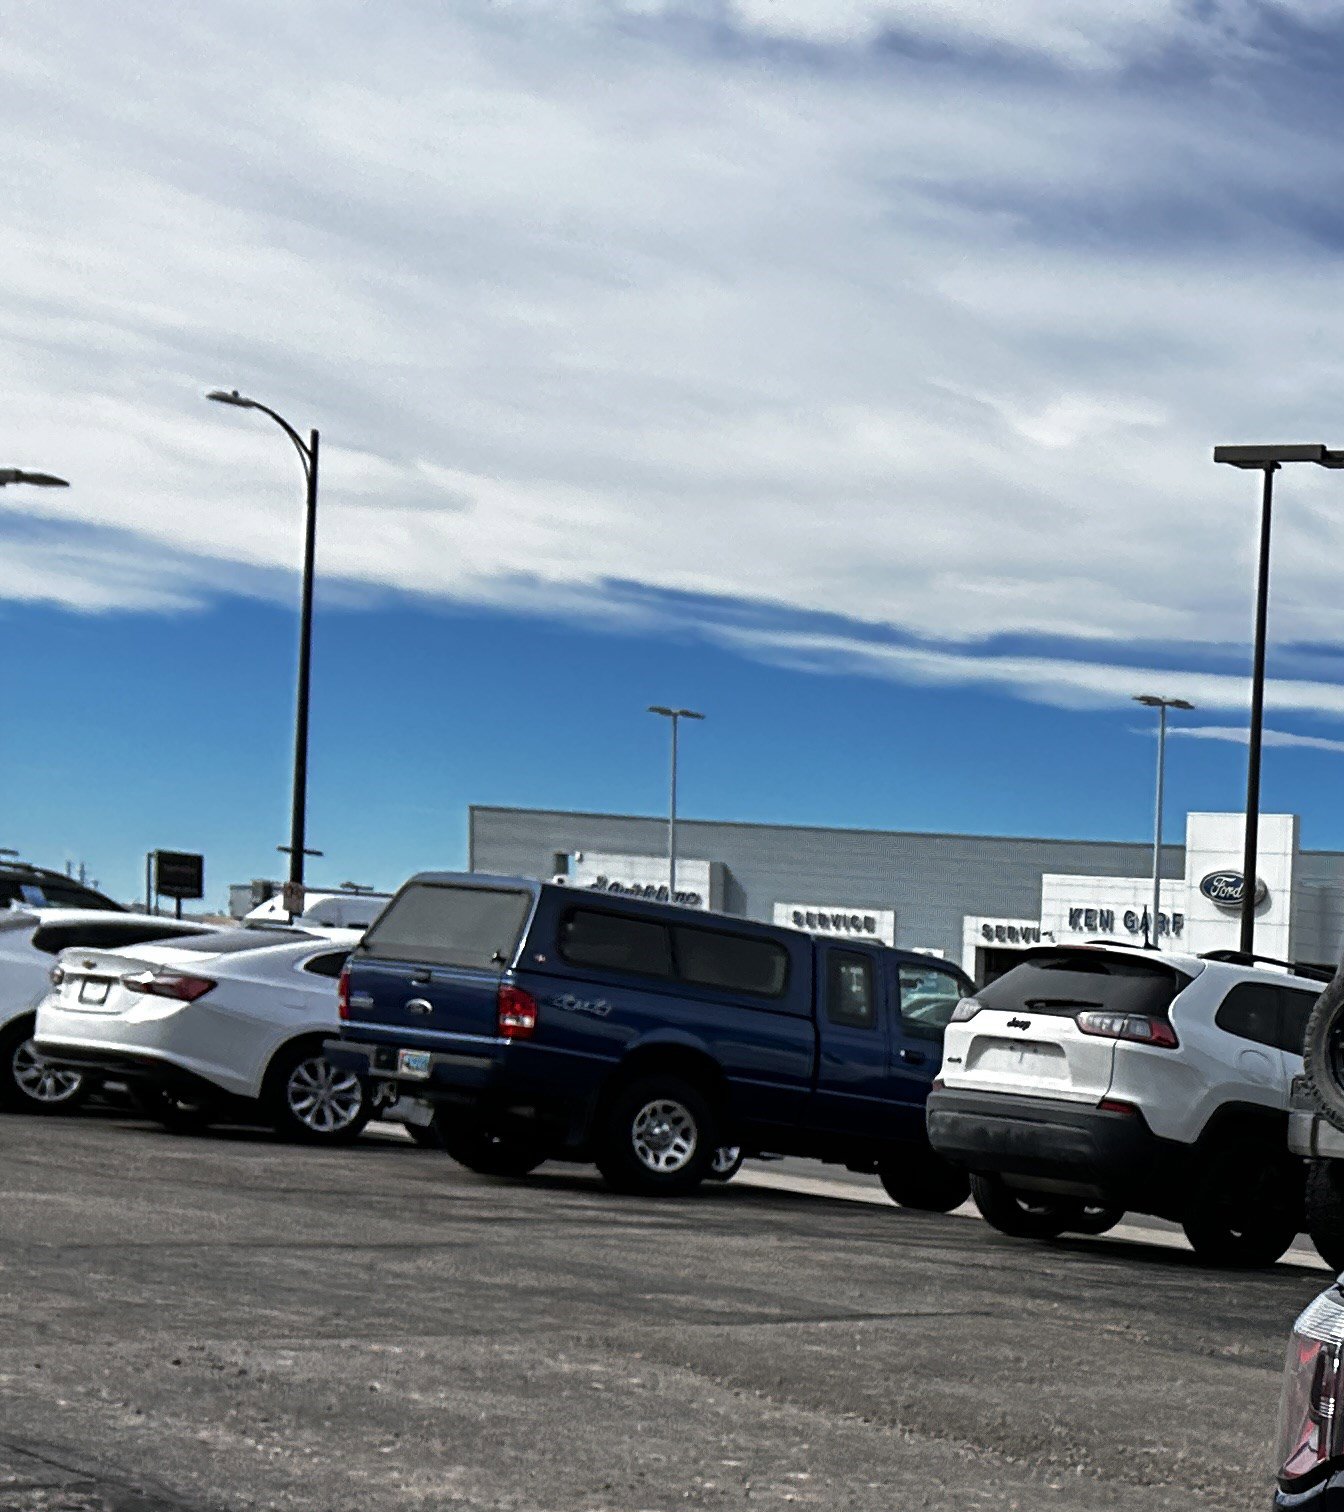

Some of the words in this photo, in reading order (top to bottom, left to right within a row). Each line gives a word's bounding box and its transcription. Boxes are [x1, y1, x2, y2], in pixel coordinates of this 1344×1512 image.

[1210, 876, 1245, 899] Ford
[793, 910, 876, 934] SERVICE
[1068, 907, 1115, 933] KEN
[982, 923, 1041, 944] SERVI
